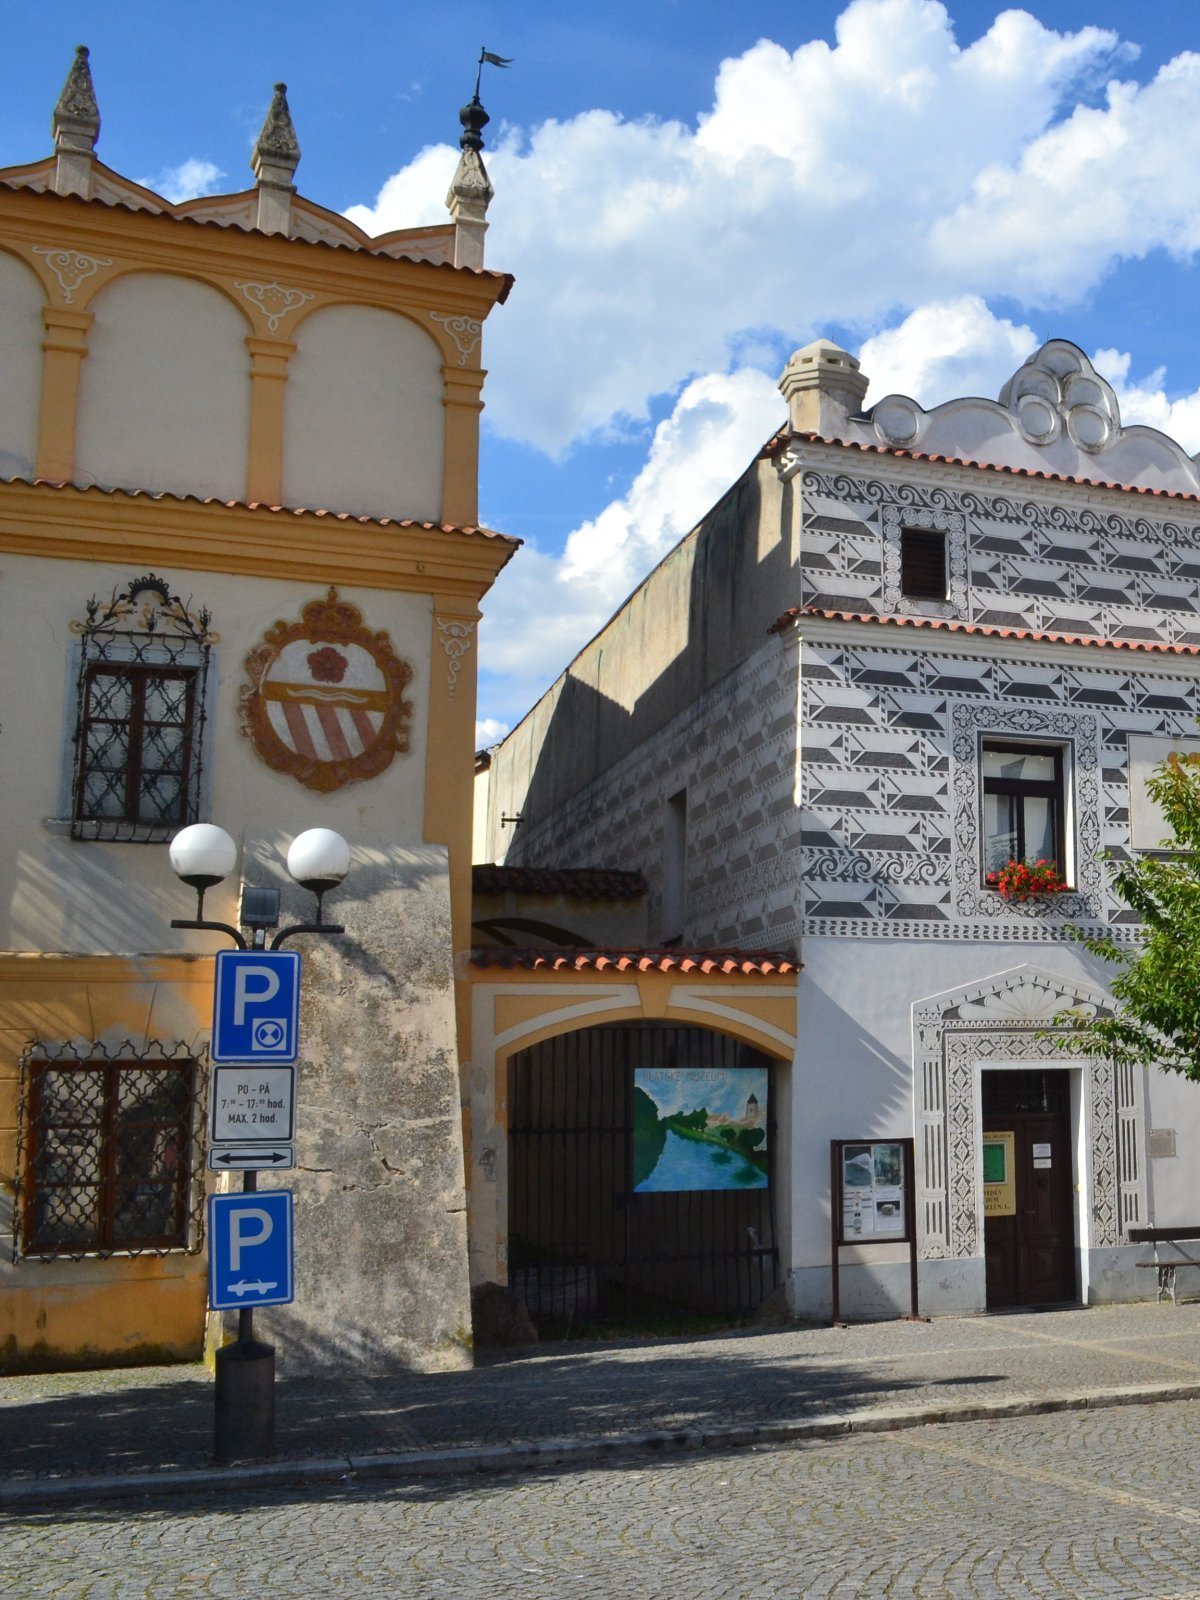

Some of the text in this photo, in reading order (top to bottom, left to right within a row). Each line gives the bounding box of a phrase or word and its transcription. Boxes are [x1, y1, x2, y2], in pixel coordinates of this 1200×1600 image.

[233, 965, 280, 1025] P
[237, 1084, 249, 1095] PO
[259, 1082, 270, 1095] PÁ
[267, 1099, 285, 1109] hod.
[228, 1113, 278, 1124] MAX. 2 hod.
[229, 1208, 274, 1272] P
